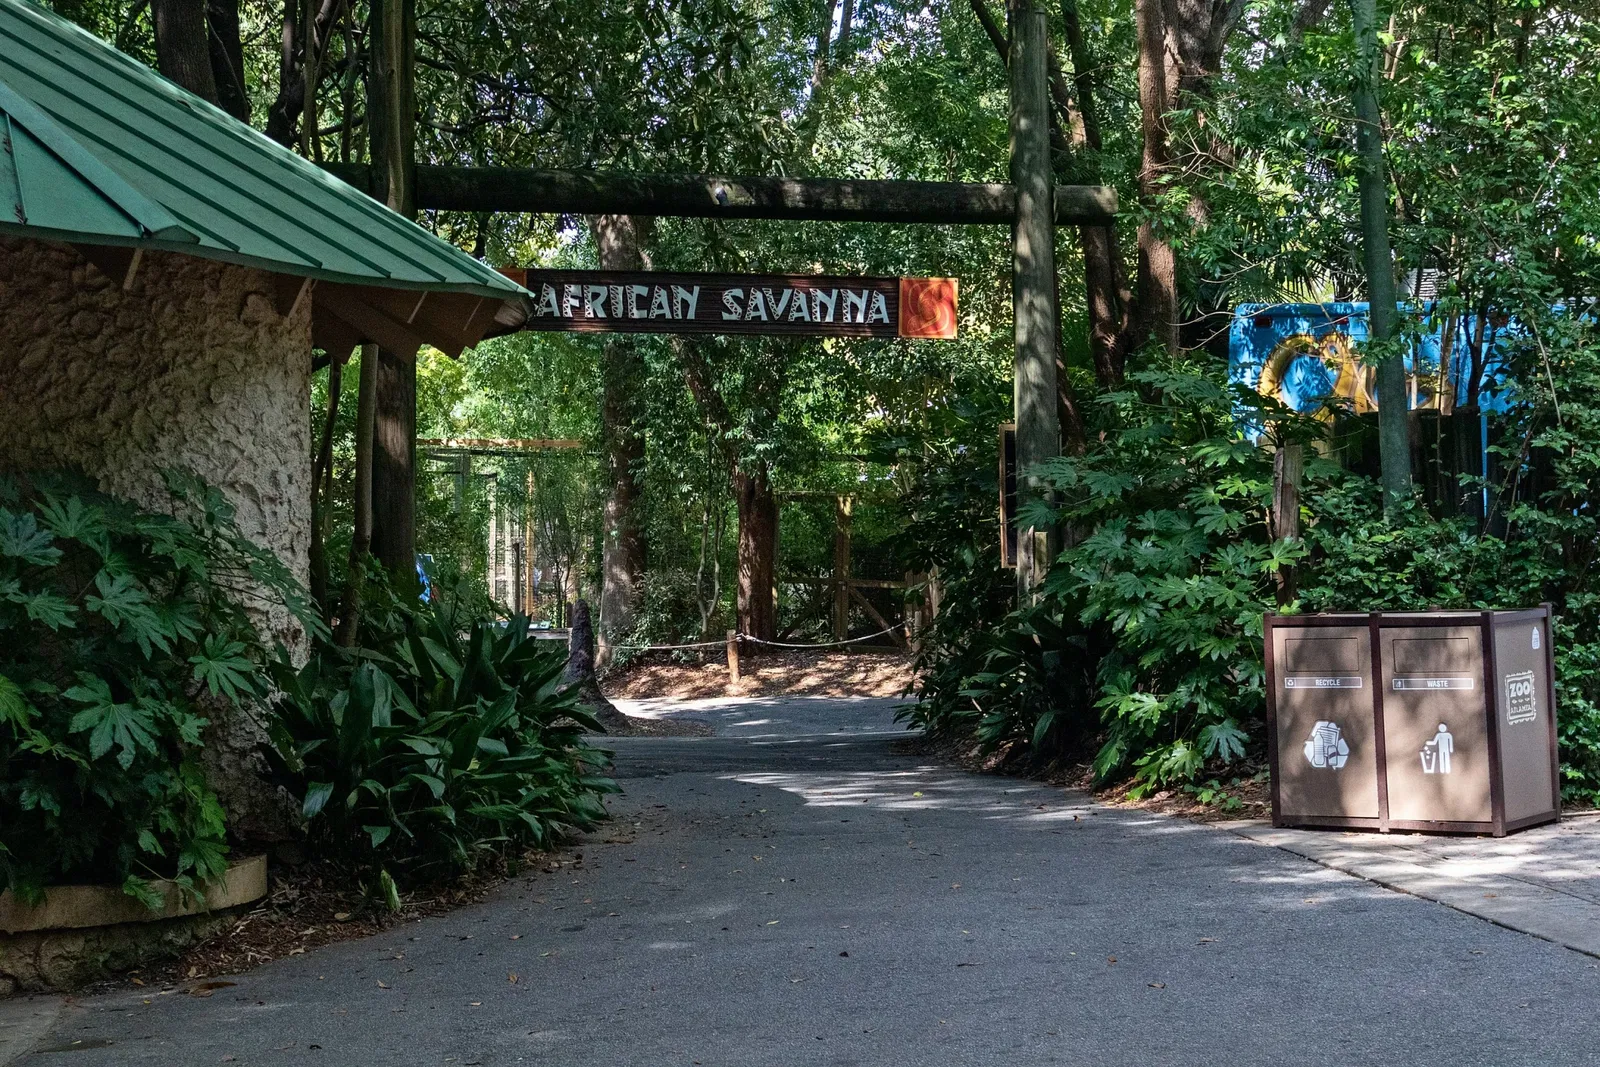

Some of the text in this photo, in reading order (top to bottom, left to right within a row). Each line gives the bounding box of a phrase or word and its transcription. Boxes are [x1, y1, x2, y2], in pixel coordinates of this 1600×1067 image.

[536, 282, 891, 324] AFRICAN SAVANNA
[1315, 678, 1340, 686] RECYCLE
[1427, 680, 1448, 688] WASTE
[1509, 681, 1531, 697] ZOO
[1510, 704, 1532, 714] ATLANTA
